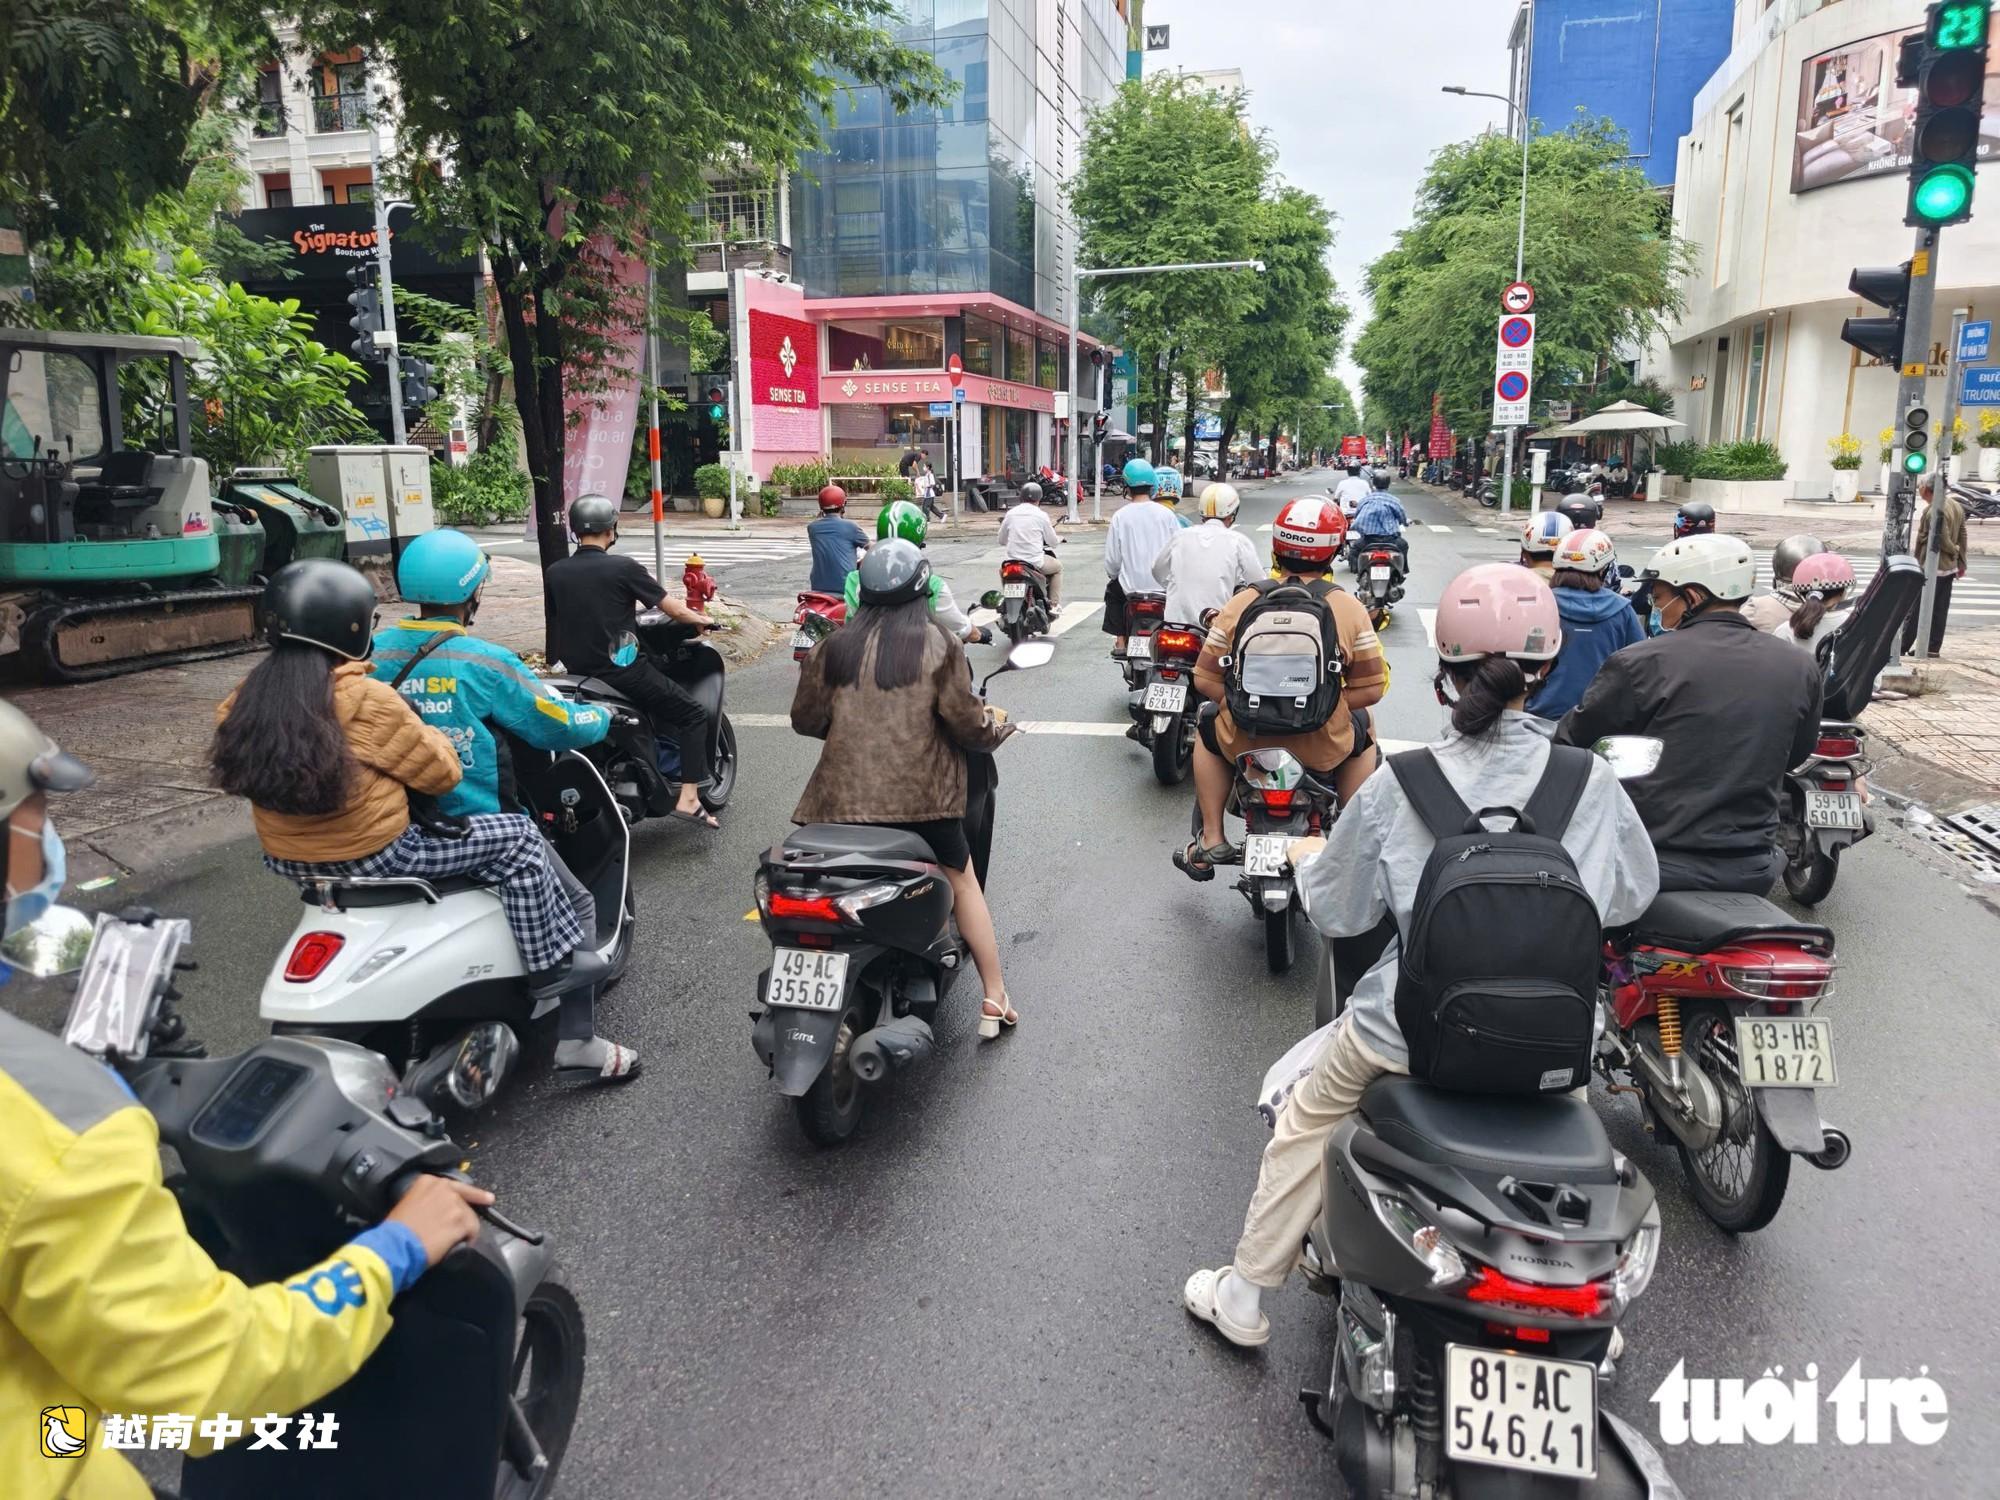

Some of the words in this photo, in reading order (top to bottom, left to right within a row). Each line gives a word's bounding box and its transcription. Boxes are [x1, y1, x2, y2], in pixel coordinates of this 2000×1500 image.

[1937, 5, 1986, 48] 23
[1898, 156, 1913, 166] GIA
[310, 224, 325, 232] The
[294, 230, 394, 254] Signatur
[335, 248, 370, 258] Boutique
[769, 387, 792, 402] SENSE
[794, 389, 806, 403] TEA
[865, 383, 908, 394] SENSE
[915, 382, 941, 393] TEA
[1280, 531, 1315, 543] DORCO
[427, 676, 457, 694] SM
[1153, 686, 1181, 699] 59-T2
[1148, 697, 1181, 711] 628.71
[782, 951, 837, 979] 49-AC
[771, 977, 839, 1007] 355.67
[1751, 1023, 1820, 1050] 83-H3
[1754, 1053, 1825, 1082] 1872
[1509, 1253, 1575, 1269] HONDA
[1470, 1356, 1572, 1413] 81-AC
[1455, 1405, 1584, 1469] 546.41
